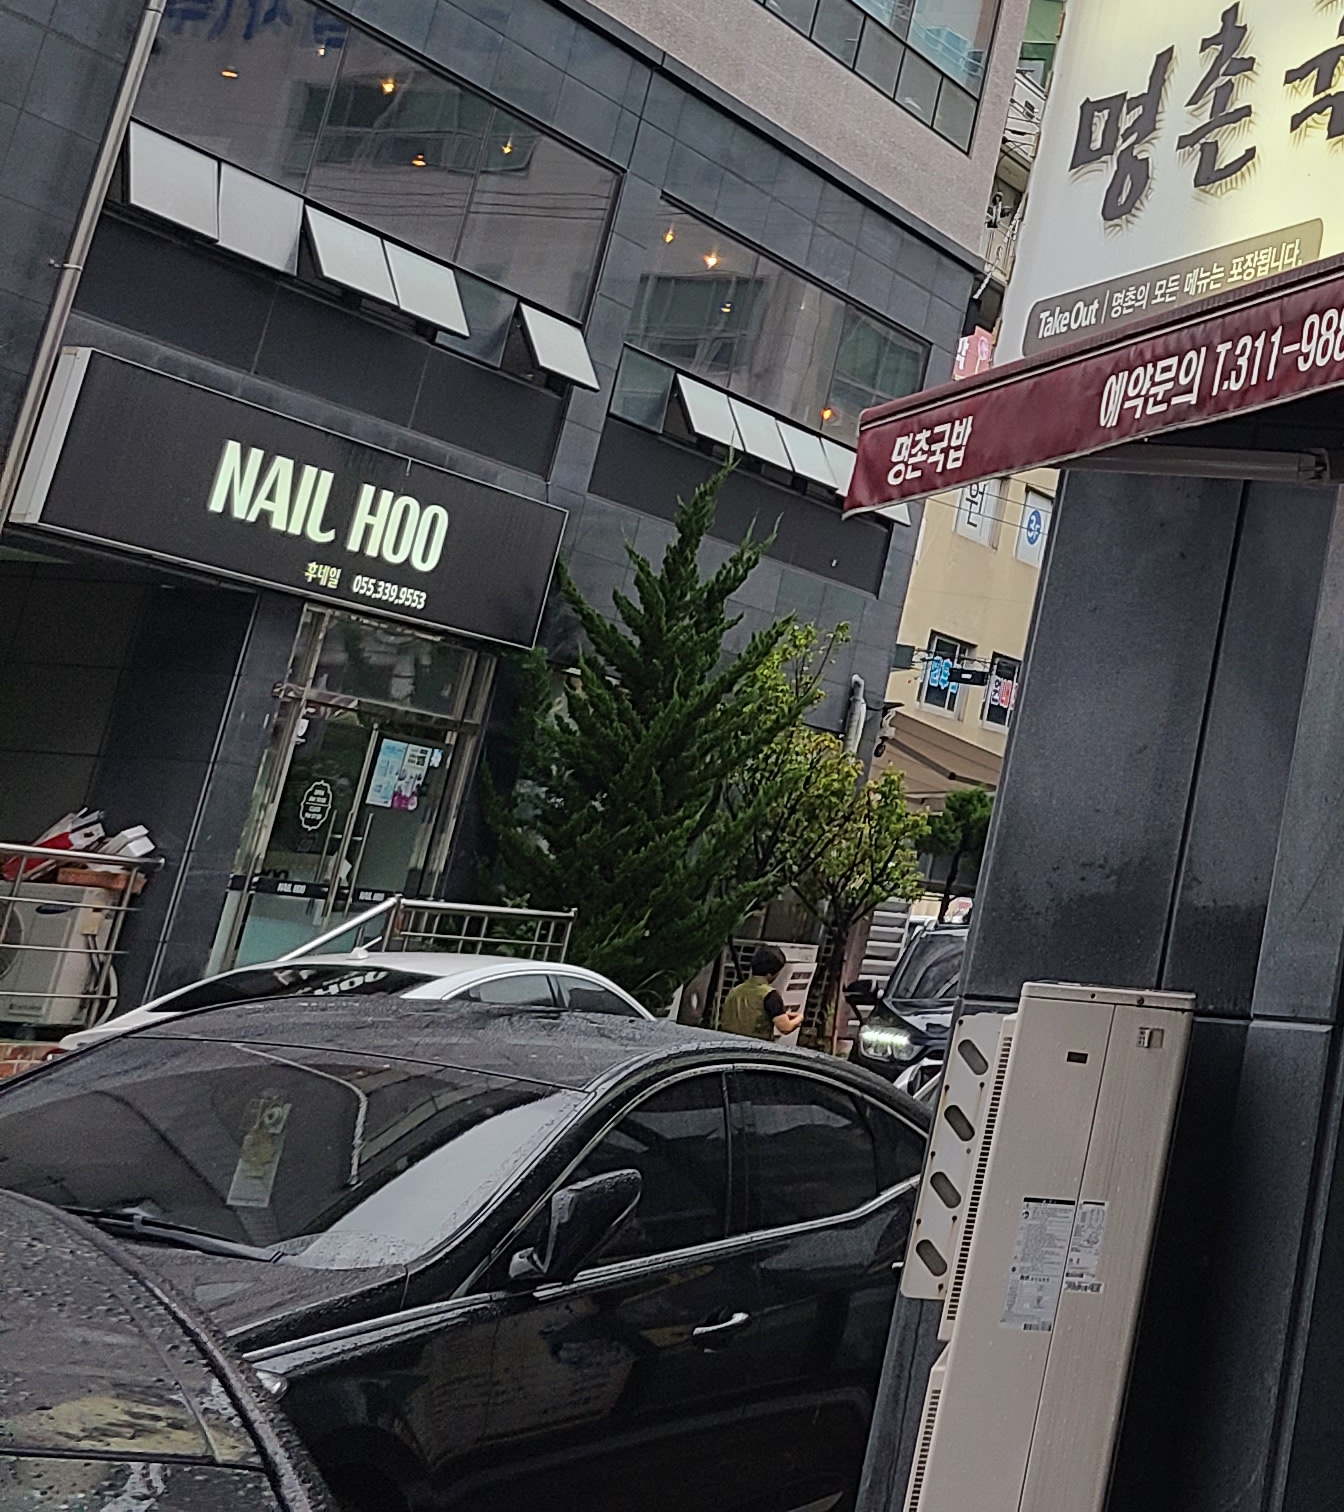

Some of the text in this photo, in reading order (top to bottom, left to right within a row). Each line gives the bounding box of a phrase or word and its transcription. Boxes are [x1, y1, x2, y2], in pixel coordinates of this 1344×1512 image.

[1110, 283, 1147, 318] 명촌의
[1151, 274, 1180, 304] 모든
[1184, 262, 1226, 296] 메뉴는
[1100, 346, 1206, 429] 예약문의
[886, 415, 973, 486] 명촌국밥
[208, 440, 449, 573] NAIL HOO
[305, 561, 342, 590] 후네일
